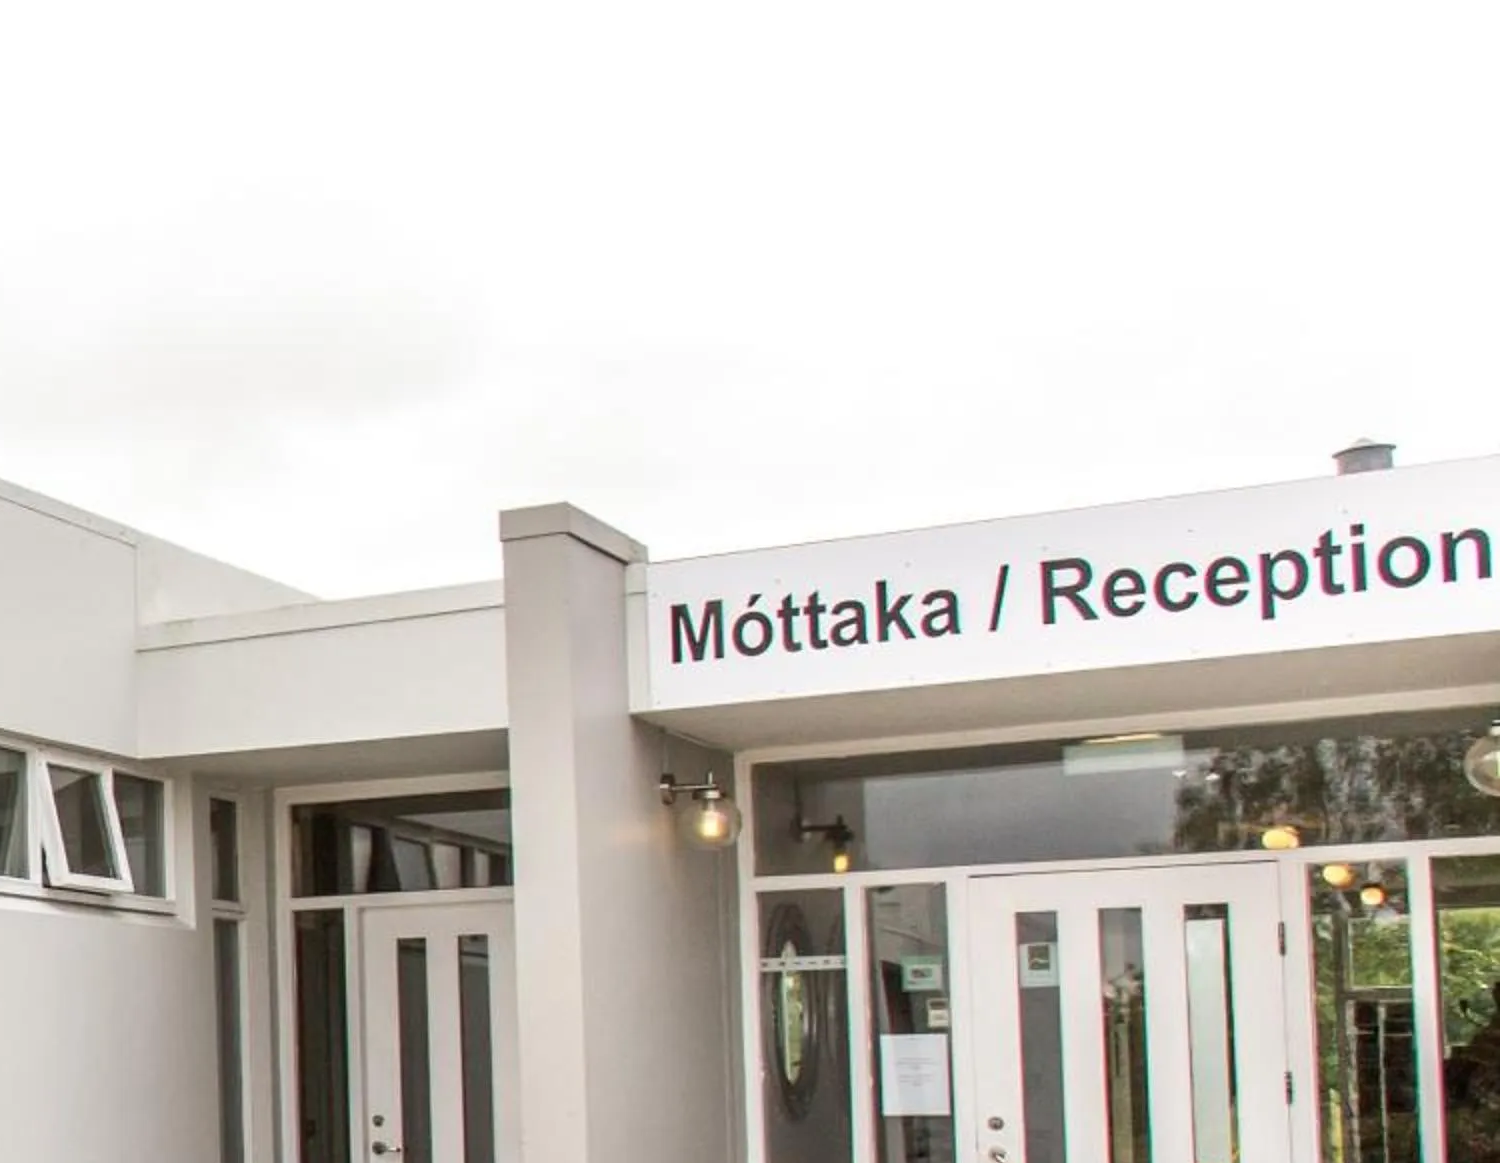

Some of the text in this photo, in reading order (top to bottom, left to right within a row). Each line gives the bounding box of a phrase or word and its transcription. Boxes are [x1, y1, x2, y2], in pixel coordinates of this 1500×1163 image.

[670, 523, 1492, 664] Móttaka / Reception
